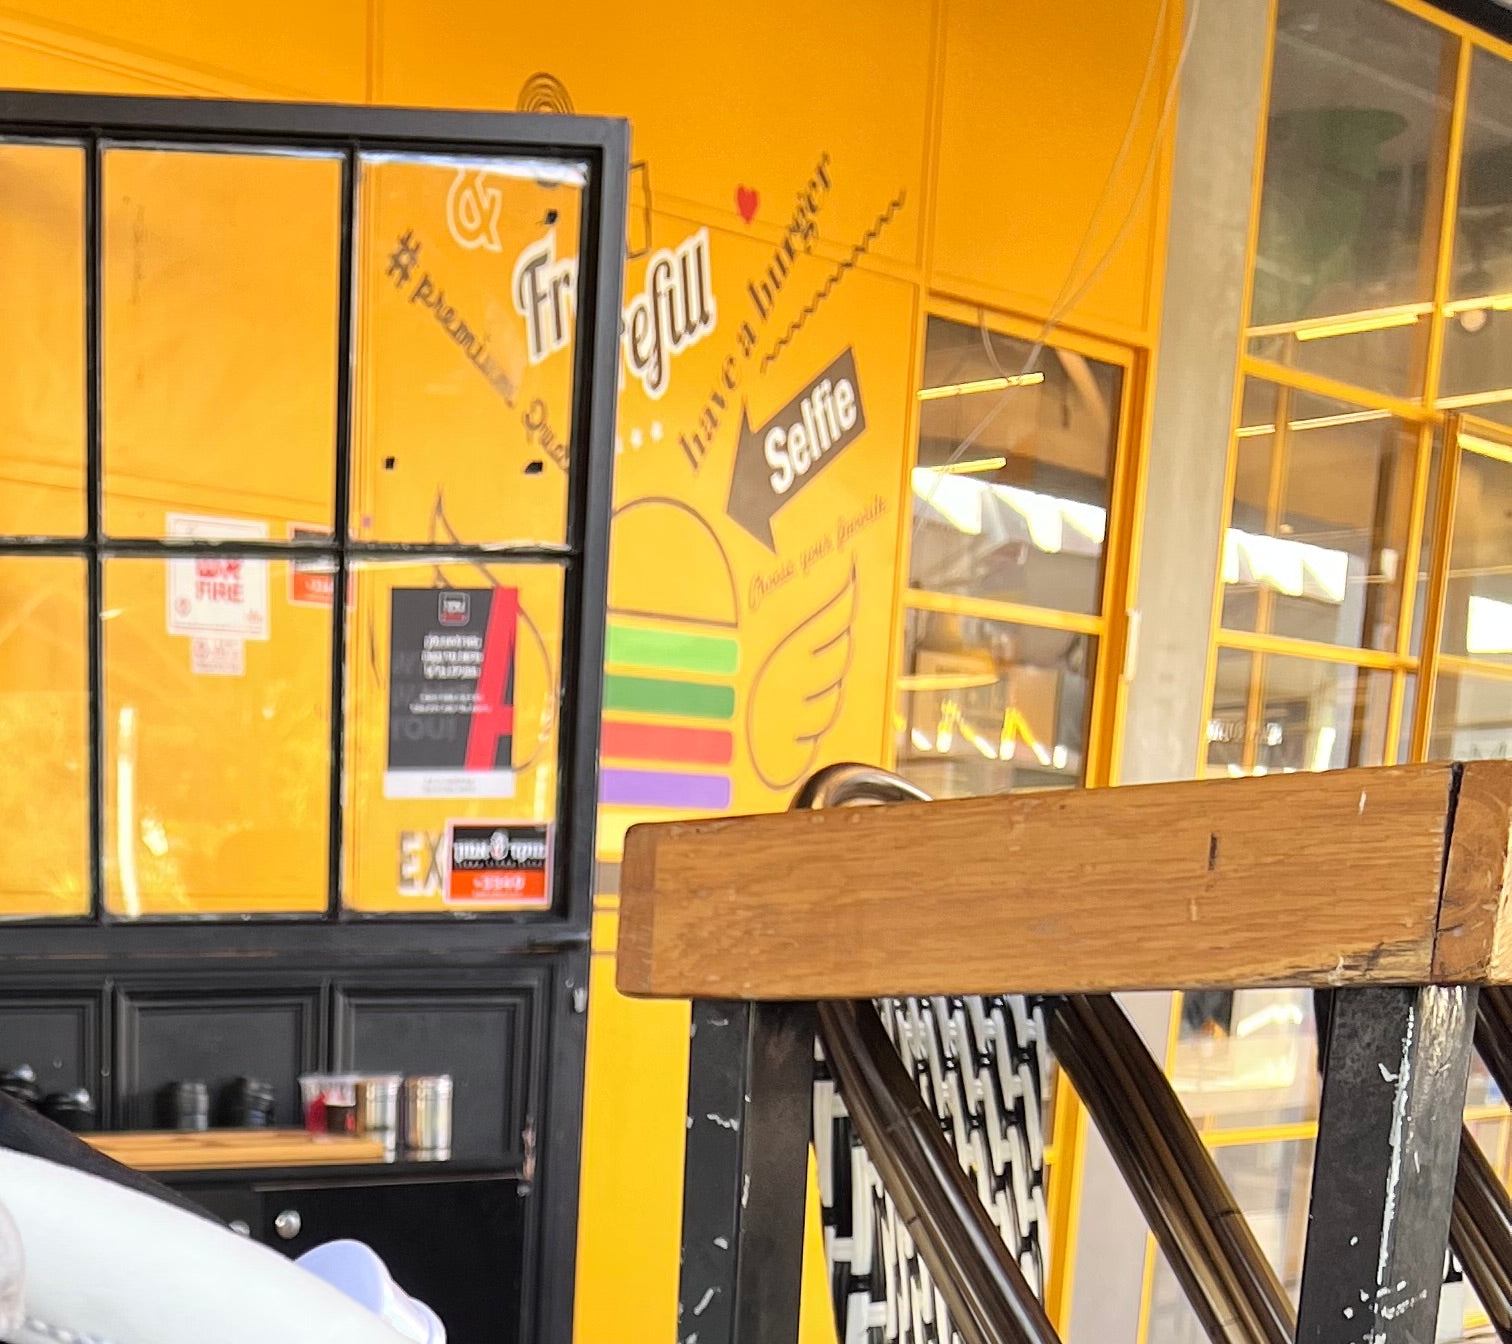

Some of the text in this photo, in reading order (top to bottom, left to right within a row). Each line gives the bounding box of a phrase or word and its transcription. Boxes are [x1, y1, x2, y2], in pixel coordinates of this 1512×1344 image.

[512, 226, 717, 398] Fr efill
[678, 151, 832, 472] have a burger
[764, 378, 857, 494] Selfie
